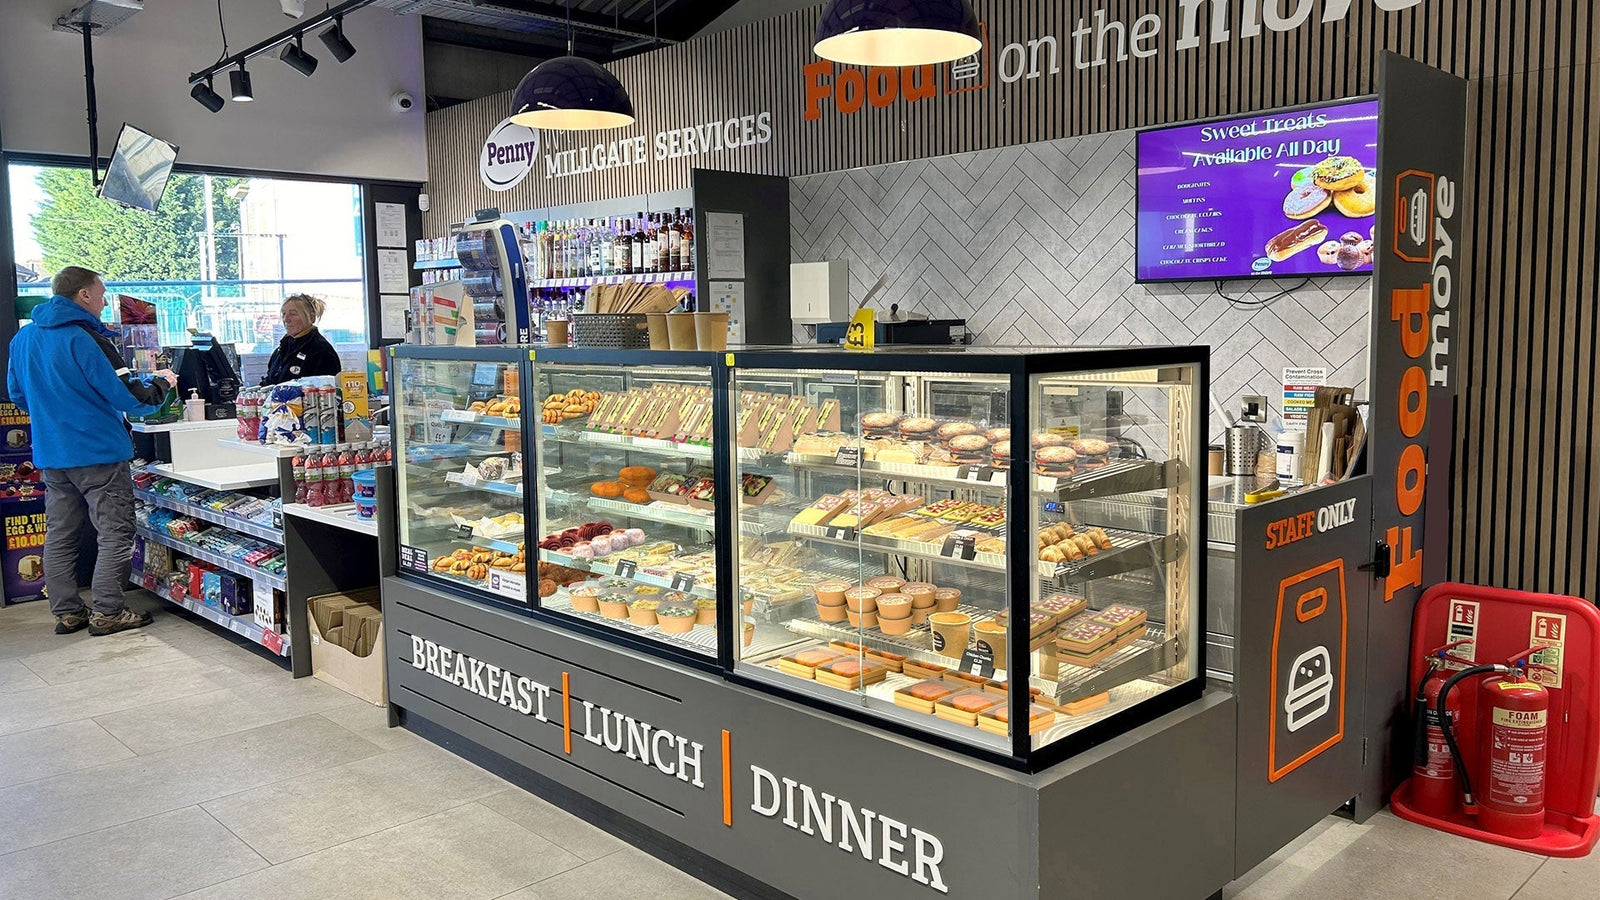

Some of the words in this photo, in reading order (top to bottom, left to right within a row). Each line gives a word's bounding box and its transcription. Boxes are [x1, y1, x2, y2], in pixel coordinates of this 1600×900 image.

[804, 59, 936, 121] Food
[999, 35, 1060, 83] on
[1072, 9, 1161, 70] the
[1176, 0, 1422, 50] mo
[1200, 120, 1258, 142] Sweet
[1262, 112, 1327, 132] Treats
[487, 141, 535, 167] Penny
[545, 135, 647, 179] MILLGATE
[655, 112, 772, 161] SERVICES
[1193, 146, 1273, 167] Available
[1275, 142, 1299, 158] All
[1303, 138, 1340, 157] Day
[1430, 175, 1454, 387] move
[847, 322, 865, 347] £3
[1384, 283, 1430, 602] Food
[5, 515, 28, 526] FIND
[5, 525, 25, 536] EGG
[26, 524, 34, 534] &
[35, 523, 47, 533] WI
[1265, 510, 1315, 550] STAFF
[1317, 497, 1357, 533] ONLY
[1508, 711, 1539, 721] FOAM
[410, 634, 550, 724] BREAKFAST
[582, 700, 705, 789] LUNCH
[750, 764, 949, 894] DINNER
